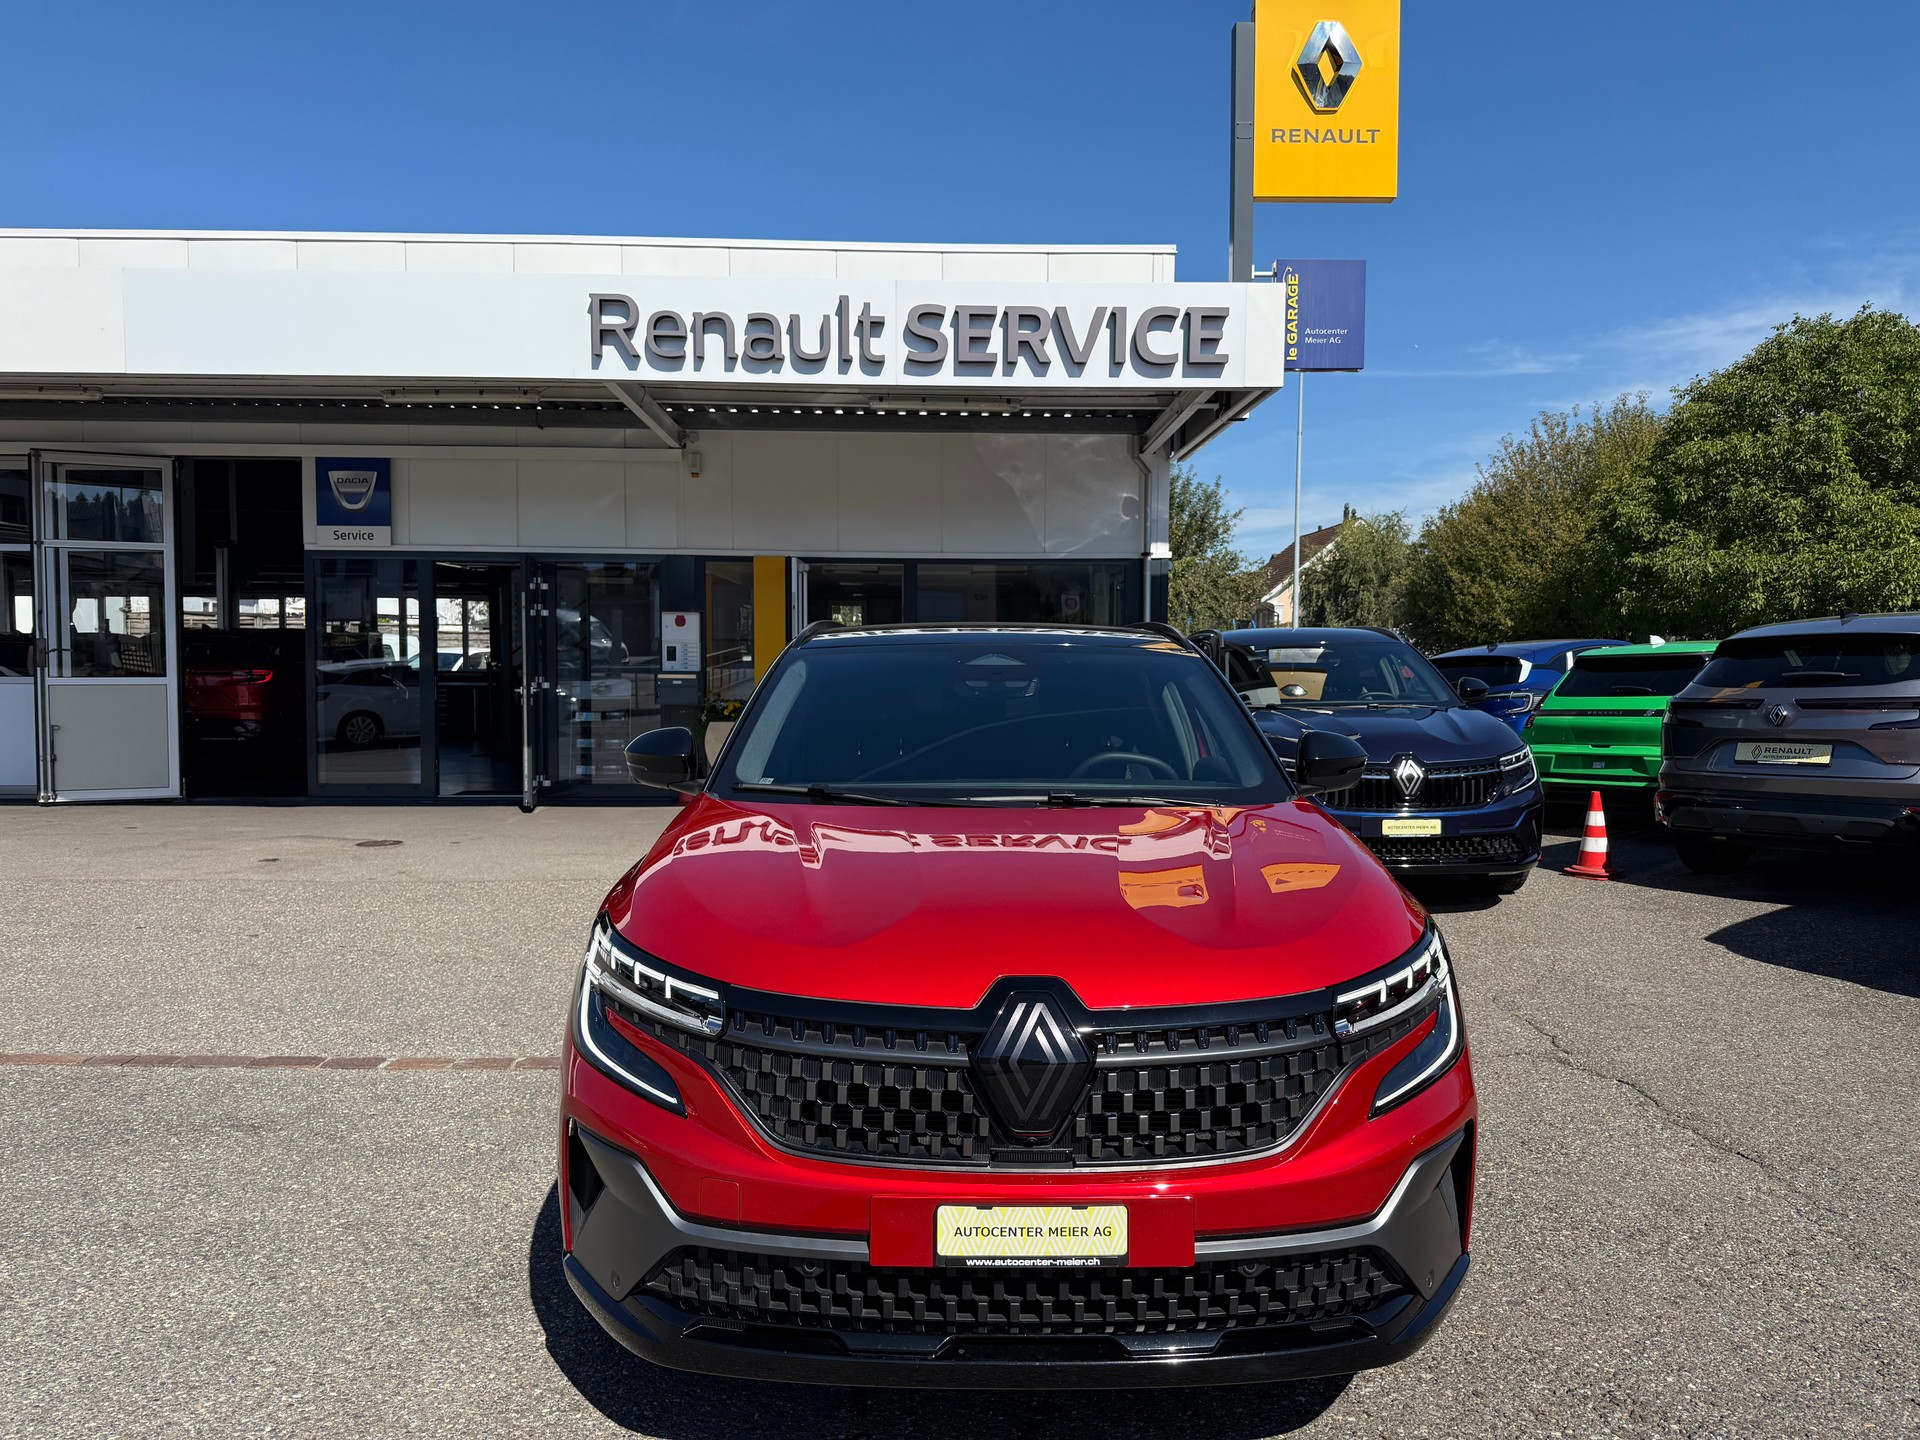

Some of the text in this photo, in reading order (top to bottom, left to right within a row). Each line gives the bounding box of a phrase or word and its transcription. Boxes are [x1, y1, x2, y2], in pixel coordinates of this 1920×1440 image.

[1271, 128, 1380, 143] RENAULT
[1286, 273, 1299, 361] le GARAGE
[587, 293, 1230, 366] Renault SERVICE
[1304, 327, 1349, 335] Autocenter
[1304, 336, 1342, 344] Meier AG
[333, 529, 375, 541] Service
[1764, 747, 1813, 755] RENAULT
[954, 1226, 1112, 1238] AUTOCENTER MEIER AG
[966, 1257, 1101, 1267] www.autocenter-meier.ch
